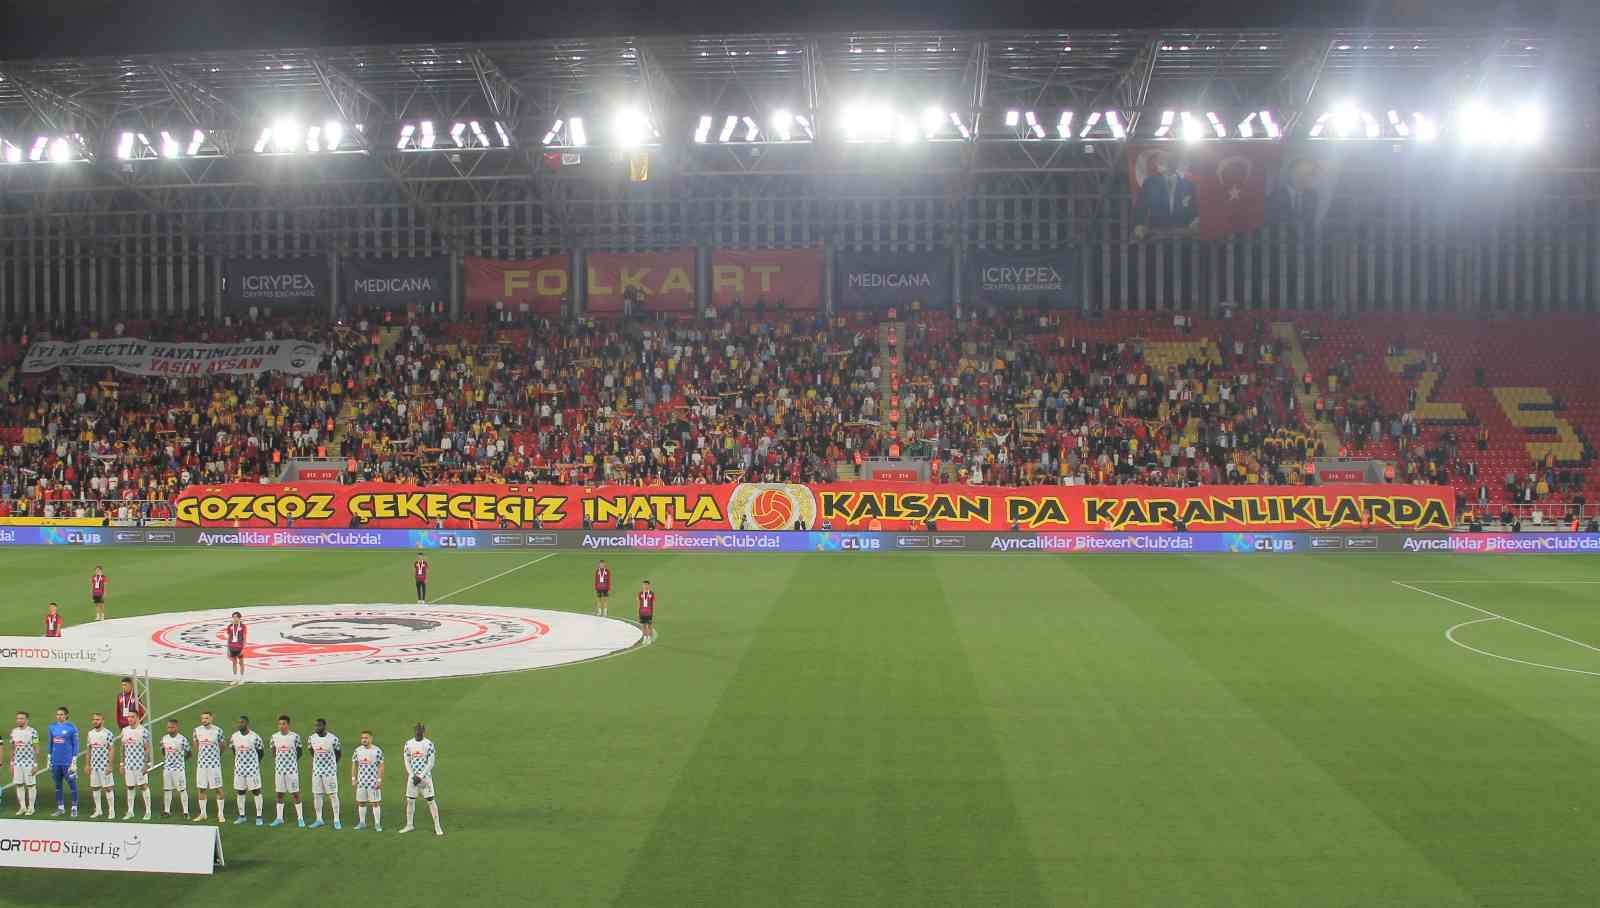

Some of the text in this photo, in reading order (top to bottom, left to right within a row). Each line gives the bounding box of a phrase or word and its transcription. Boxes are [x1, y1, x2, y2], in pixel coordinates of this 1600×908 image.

[354, 278, 431, 293] MEDICANA
[849, 272, 930, 288] MEDICANA
[176, 486, 335, 525] GÖZGÖZ
[582, 487, 723, 526] İNATLA
[820, 491, 992, 526] KALSAN
[1005, 496, 1069, 528] DA
[1083, 495, 1455, 529] KARANLIKLARDA
[67, 533, 102, 543] CLUB
[198, 532, 381, 546] Ayrıcalıklar Bitexen Club'da!
[439, 536, 476, 546] CLUB
[582, 534, 780, 549] Ayrıcalıklar Bitexen Club'da!
[841, 538, 880, 548] CLUB
[991, 536, 1193, 550] Ayrıcalıklar Bitexen Club'da!
[1254, 539, 1294, 550] CLUB
[1403, 537, 1483, 551] Ayrıcalıklar
[1486, 537, 1540, 550] Bitexen
[365, 656, 442, 664] 2022
[0, 839, 120, 858] ORTOTO SüperLig
